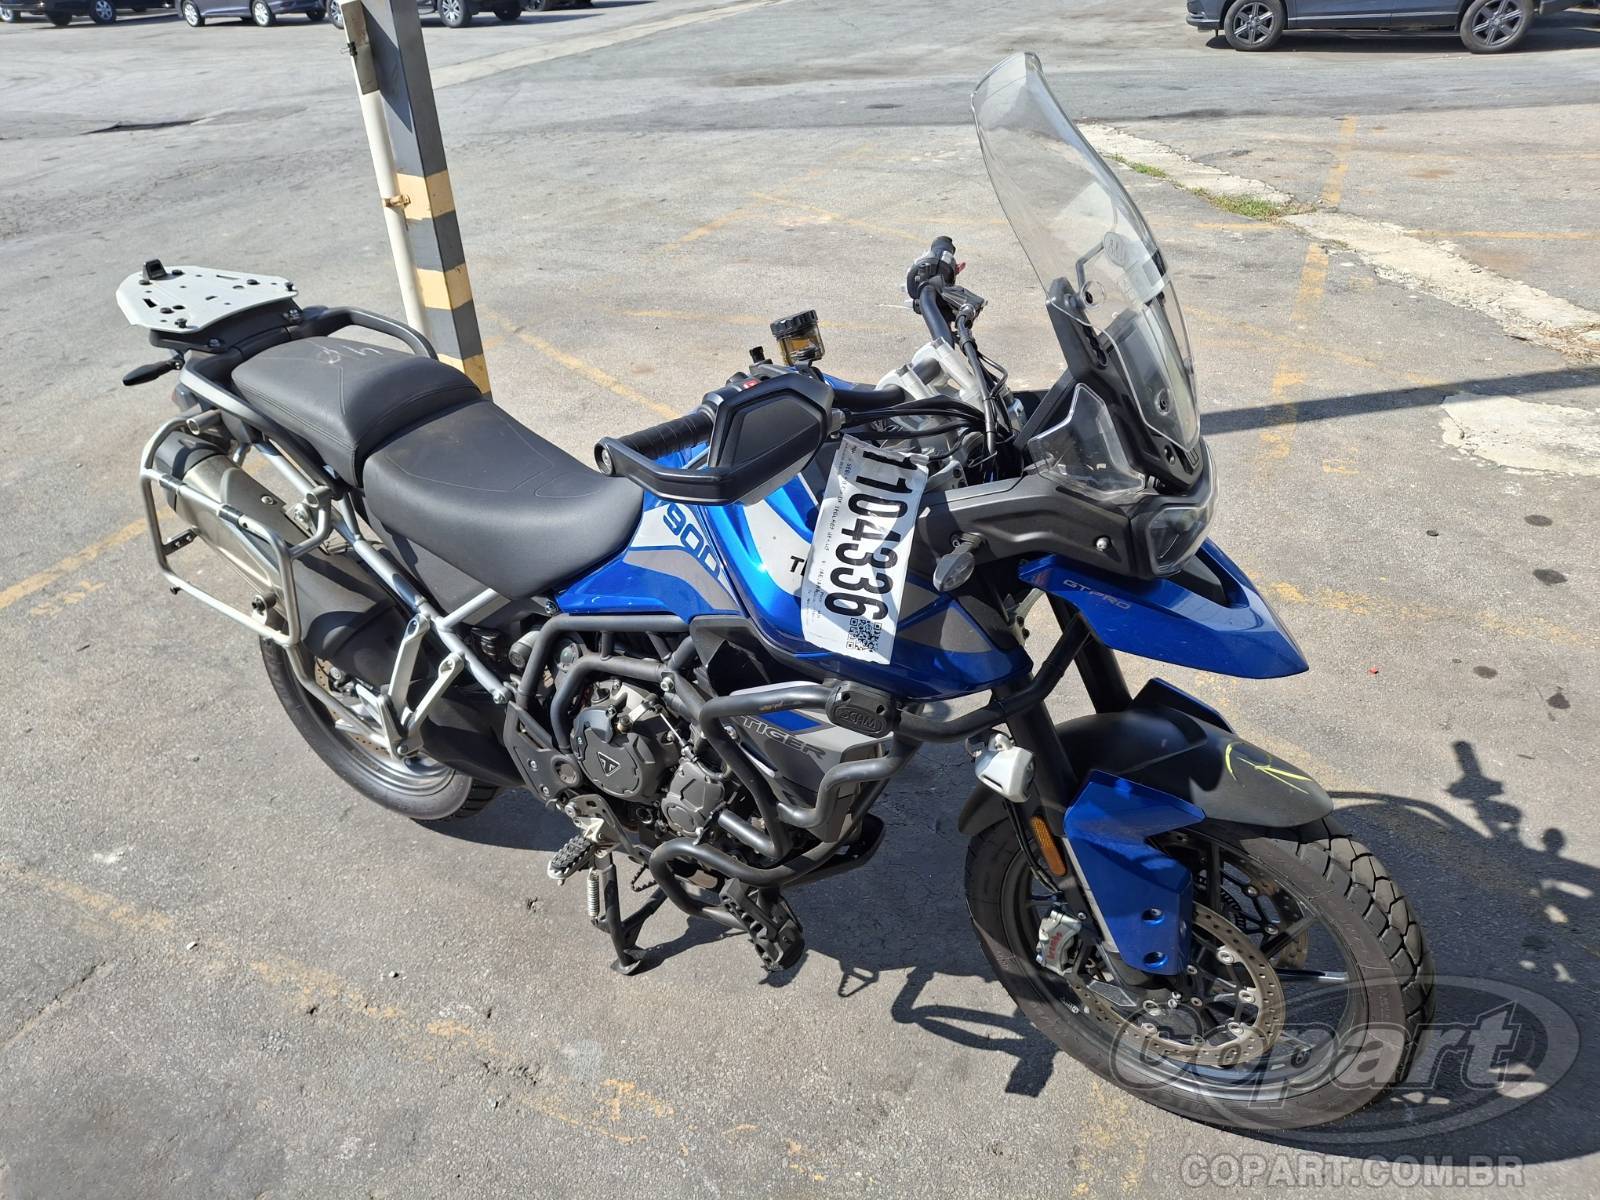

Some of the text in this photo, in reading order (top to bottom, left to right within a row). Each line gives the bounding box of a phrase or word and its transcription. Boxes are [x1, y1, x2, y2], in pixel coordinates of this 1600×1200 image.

[663, 503, 720, 578] 900
[824, 451, 917, 620] 1104336
[740, 715, 826, 759] TIGER
